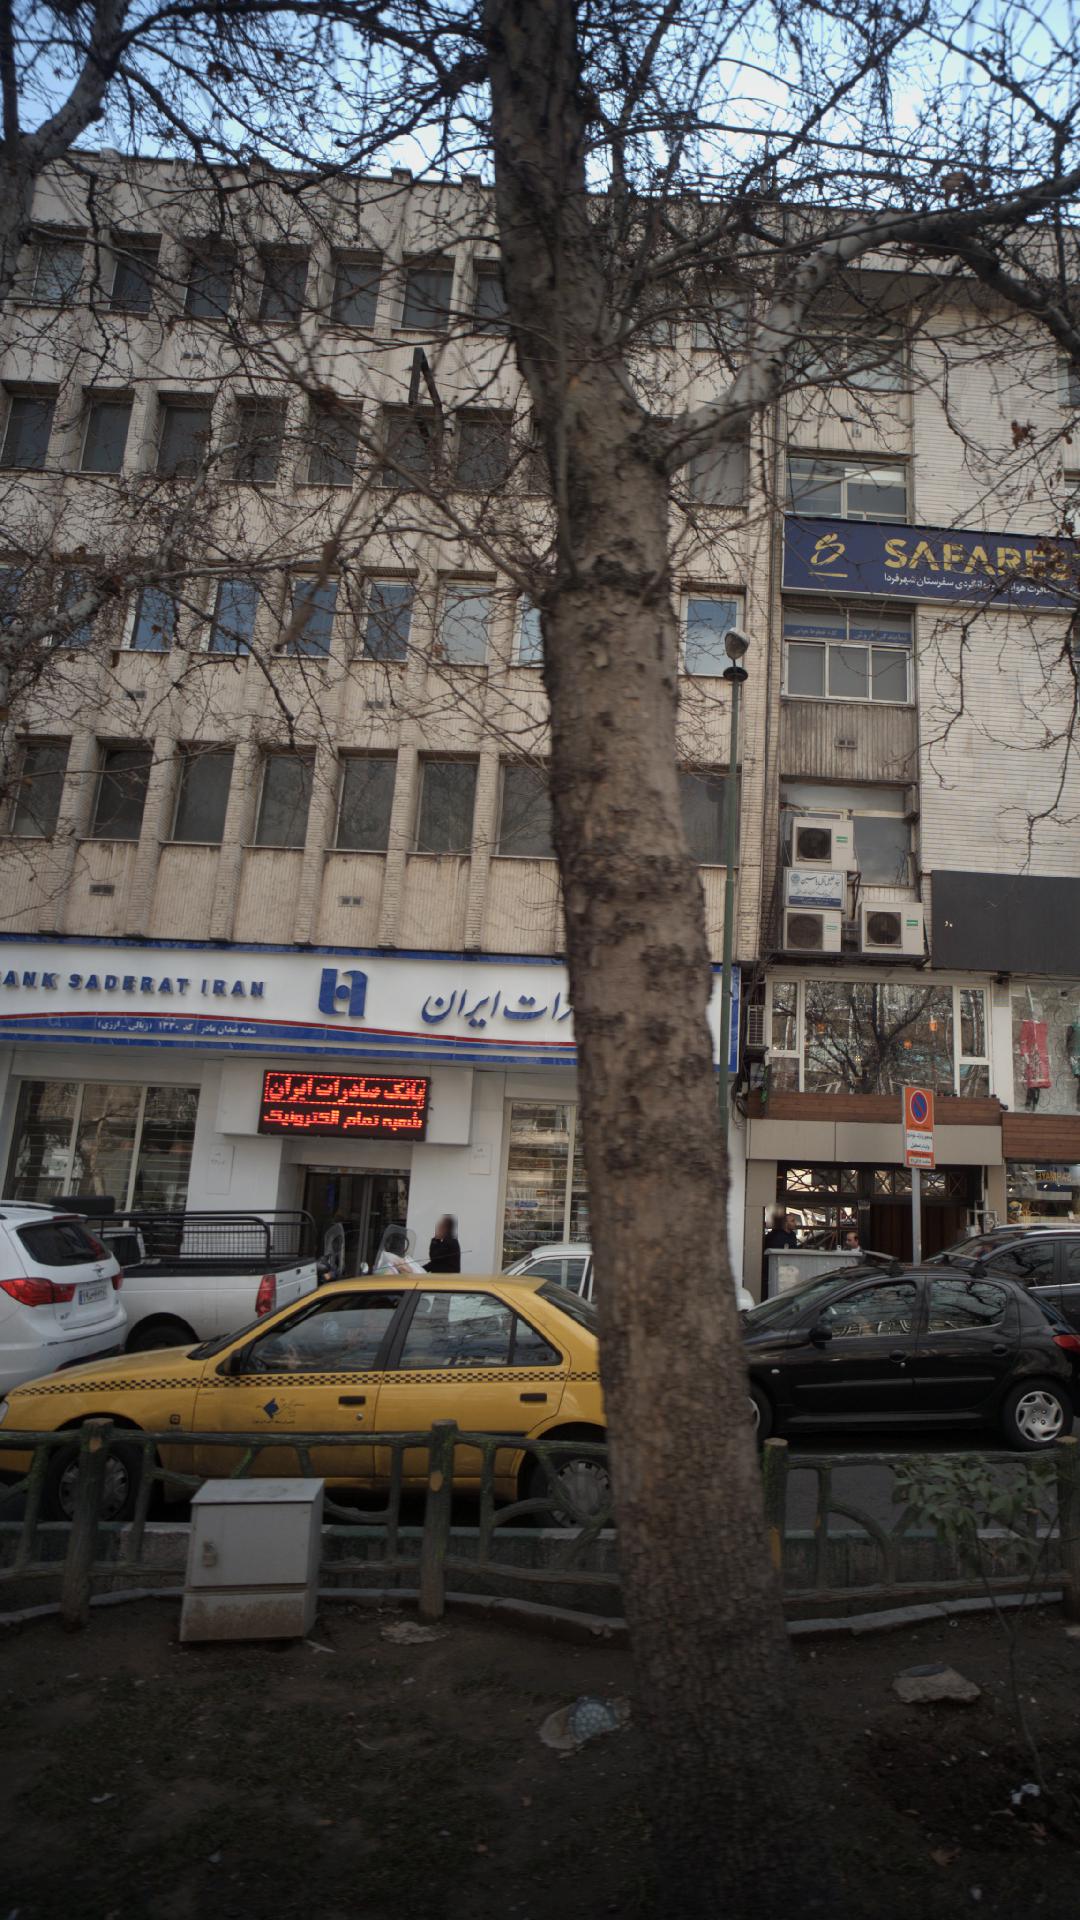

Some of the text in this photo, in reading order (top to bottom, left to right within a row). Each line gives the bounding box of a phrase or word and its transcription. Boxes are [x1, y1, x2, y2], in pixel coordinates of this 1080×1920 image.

[916, 576, 954, 588] سفرستان
[1027, 586, 1057, 596] سافرت
[0, 970, 266, 999] ANK SADERAT IRAN
[421, 989, 573, 1029] رات ایران
[182, 1023, 194, 1032] کد
[200, 1023, 217, 1035] مادر
[240, 1025, 257, 1034] شعبه
[268, 1077, 425, 1106] بانک صادرات ایران
[263, 1110, 423, 1131] شعبه تمام الکترونیک
